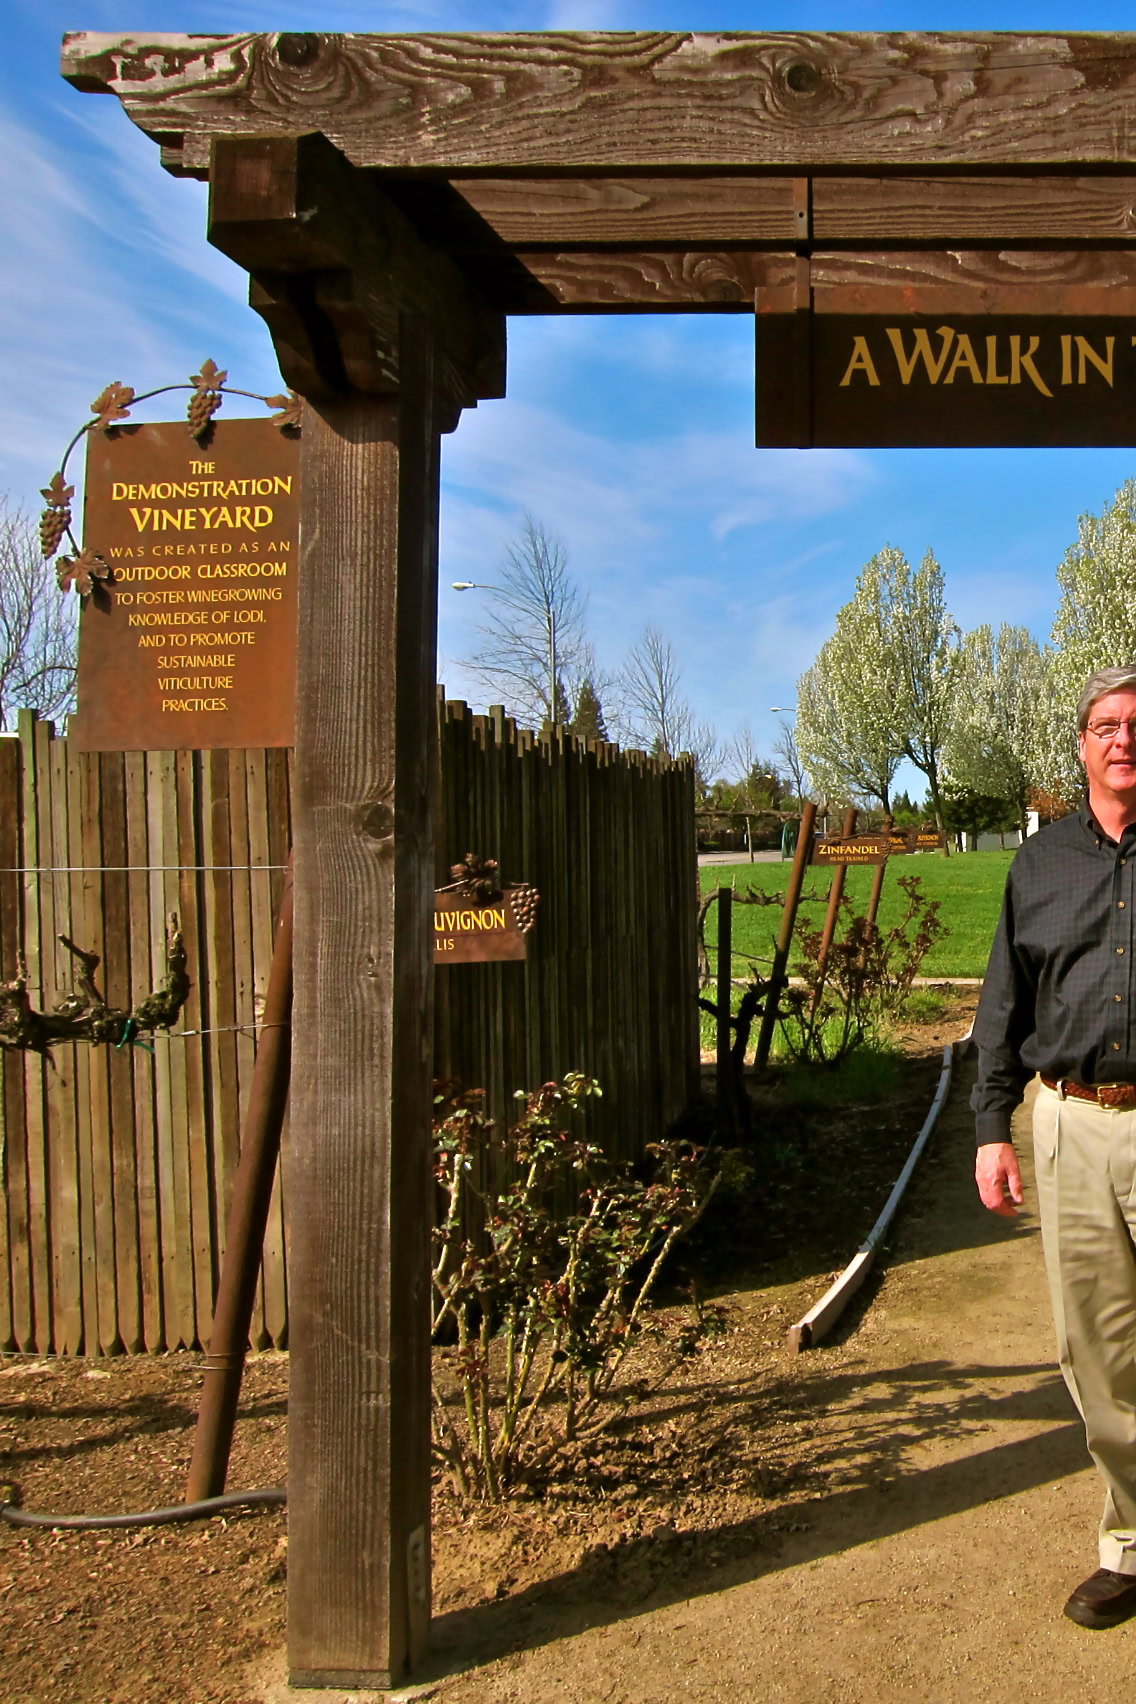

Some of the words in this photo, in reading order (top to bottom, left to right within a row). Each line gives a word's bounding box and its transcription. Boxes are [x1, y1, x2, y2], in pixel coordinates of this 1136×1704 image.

[839, 336, 880, 386] A
[885, 326, 1053, 397] WALK
[1060, 335, 1115, 388] IN
[189, 461, 215, 474] THE
[112, 476, 292, 500] DEMONSTRATION
[129, 506, 273, 532] VINEYARD
[110, 547, 145, 558] WAS
[152, 543, 232, 556] CREATED
[239, 542, 259, 553] AS
[268, 541, 290, 552] AN
[114, 565, 191, 582] OUTDOOR
[197, 562, 287, 578] CLASSROOM
[115, 592, 133, 605] TO
[136, 591, 184, 605] FOSTER
[187, 588, 282, 603] WINEGROWING
[128, 611, 208, 626] KNOWLEDGE
[211, 611, 231, 624] OF
[138, 634, 165, 647] AND
[169, 634, 187, 646] TO
[190, 632, 255, 646] PROMOTE
[157, 654, 235, 669] SUSTAINABLE
[158, 676, 233, 690] VITICULTURE
[162, 698, 228, 712] PRACTICES.
[818, 845, 880, 855] ZINFANDEL
[434, 909, 506, 932] UVIGNON
[435, 938, 455, 951] LIS
